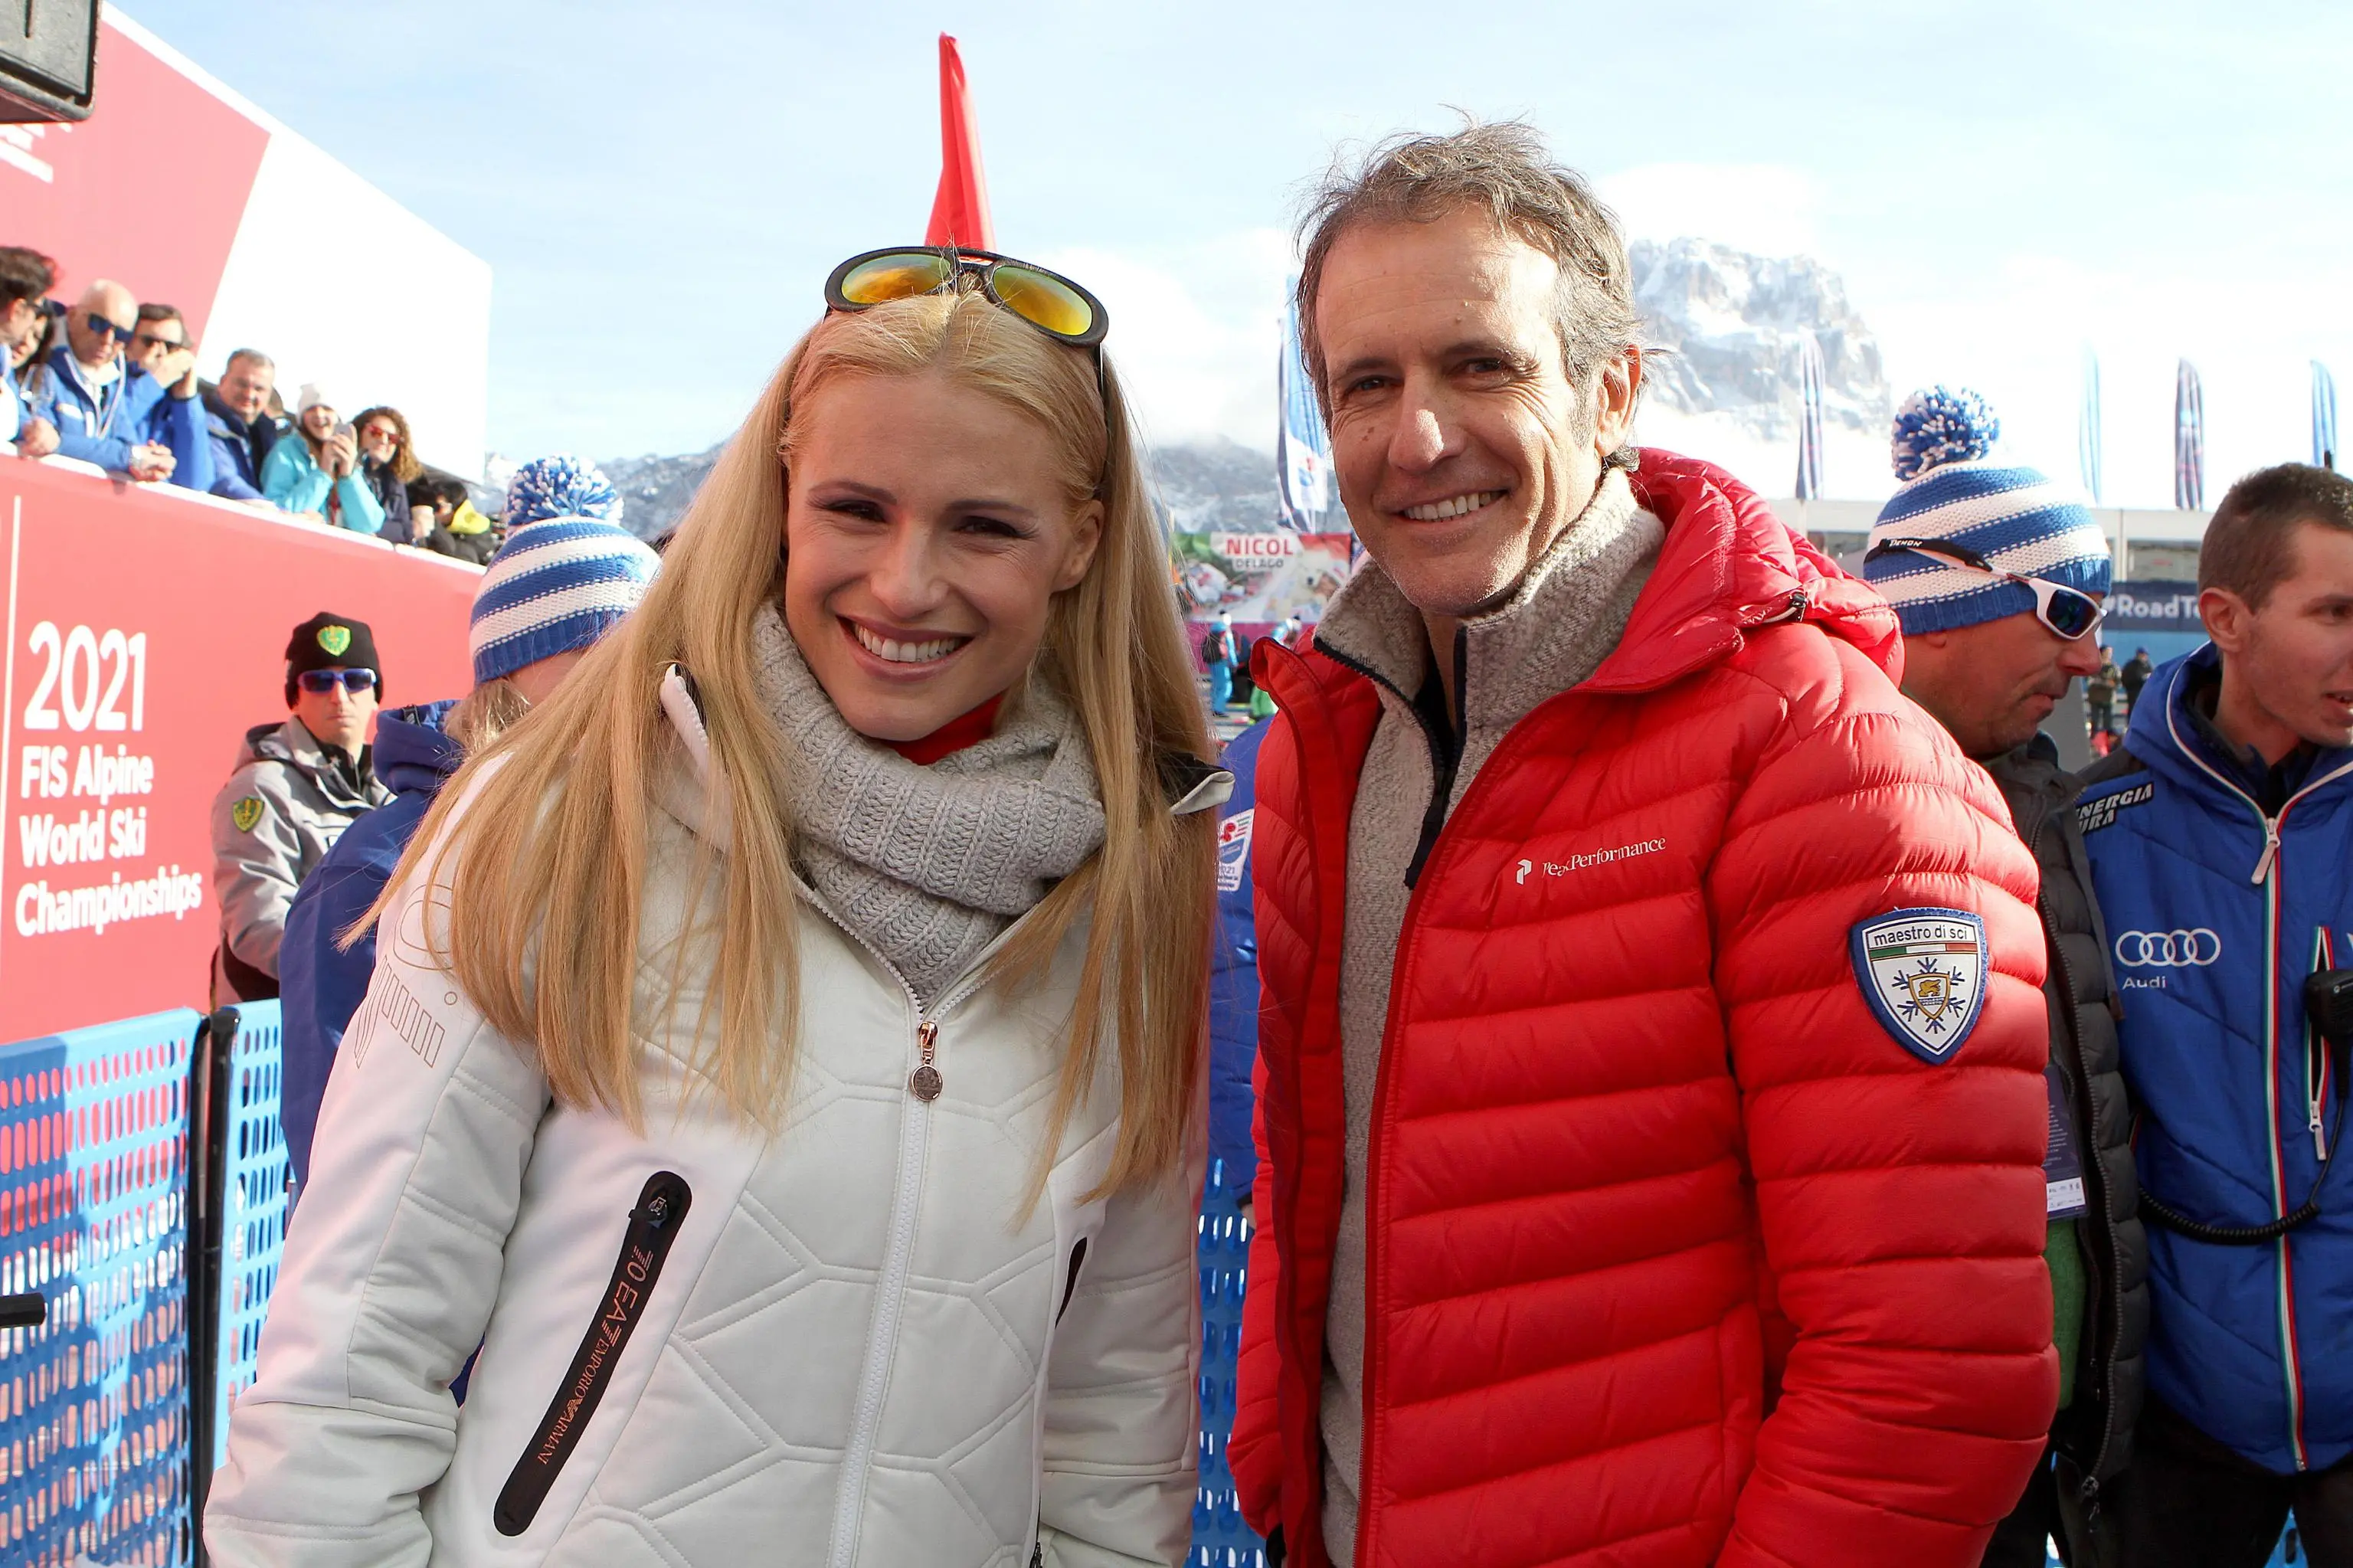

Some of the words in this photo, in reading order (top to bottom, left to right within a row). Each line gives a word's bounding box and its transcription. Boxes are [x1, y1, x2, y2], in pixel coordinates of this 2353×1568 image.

[1227, 538, 1294, 555] NICOL
[1889, 539, 1923, 548] DEMON
[24, 620, 146, 732] 2021
[21, 745, 68, 798] FIS
[73, 744, 154, 805] Alpine
[2076, 784, 2152, 820] NERGIA
[19, 809, 105, 867] World
[109, 807, 147, 859] Ski
[15, 864, 202, 937] Championships
[1874, 926, 1932, 946] maestro
[1935, 925, 1946, 939] di
[1949, 927, 1968, 940] sci
[2122, 976, 2166, 990] Audi
[574, 1338, 610, 1398] EMPORIO
[538, 1411, 571, 1465] ARMANI
